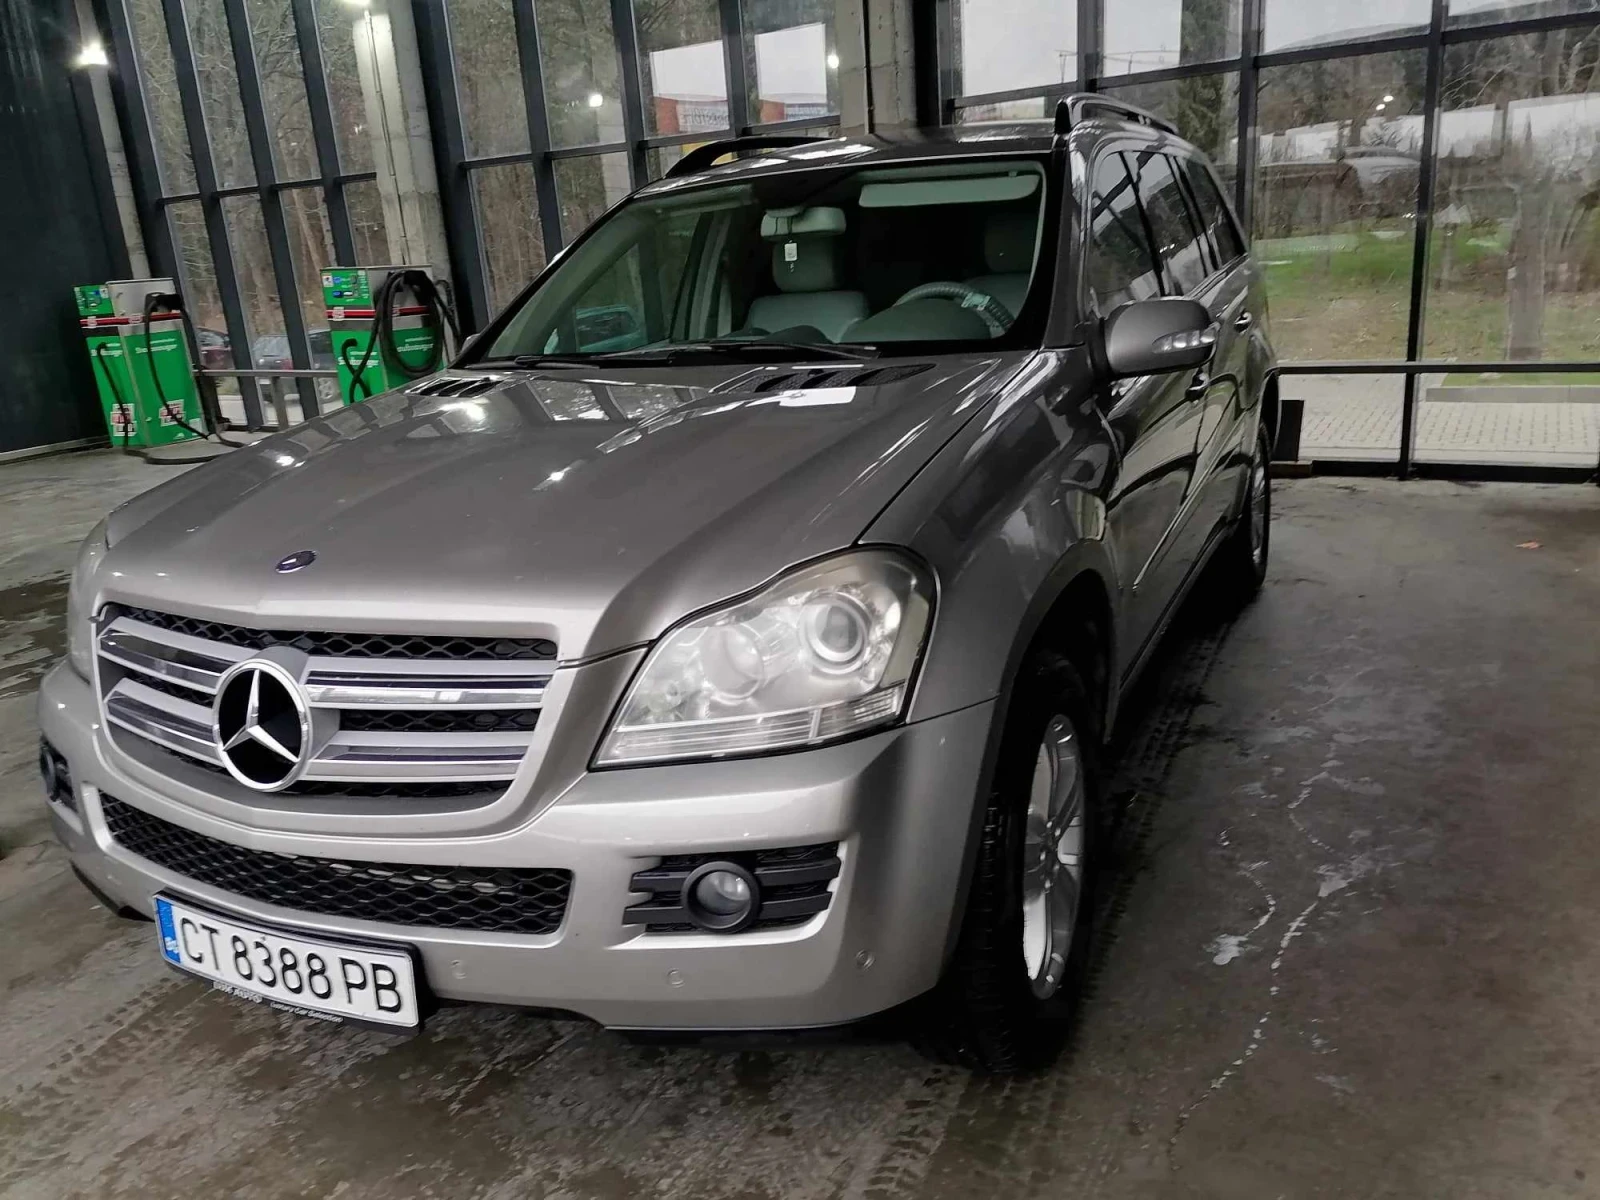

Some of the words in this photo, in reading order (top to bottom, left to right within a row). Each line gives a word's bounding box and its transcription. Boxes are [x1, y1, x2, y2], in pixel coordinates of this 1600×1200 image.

[181, 917, 219, 971] CT
[232, 935, 331, 1000] 8388
[339, 956, 402, 1013] PB
